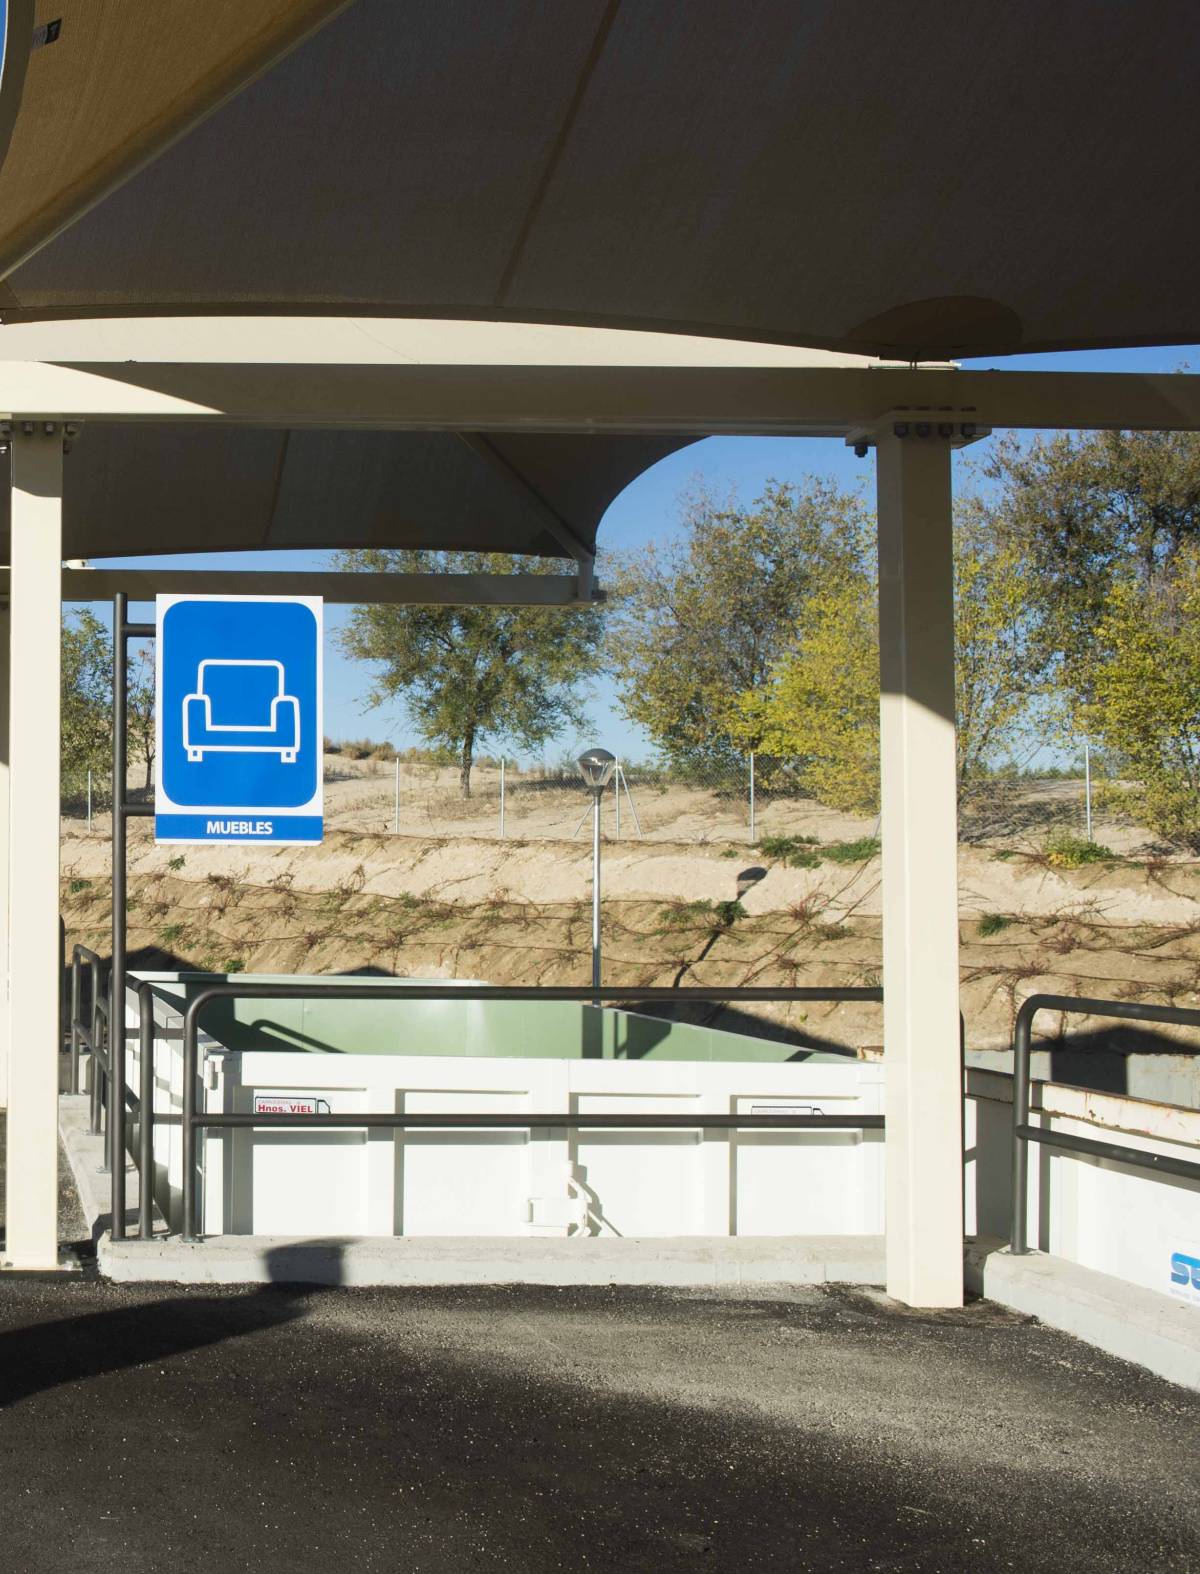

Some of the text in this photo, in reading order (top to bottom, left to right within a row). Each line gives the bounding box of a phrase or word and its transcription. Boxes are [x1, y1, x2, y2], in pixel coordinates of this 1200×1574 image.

[206, 820, 273, 835] MUEBLES
[258, 1104, 314, 1113] Hnos. VIEL
